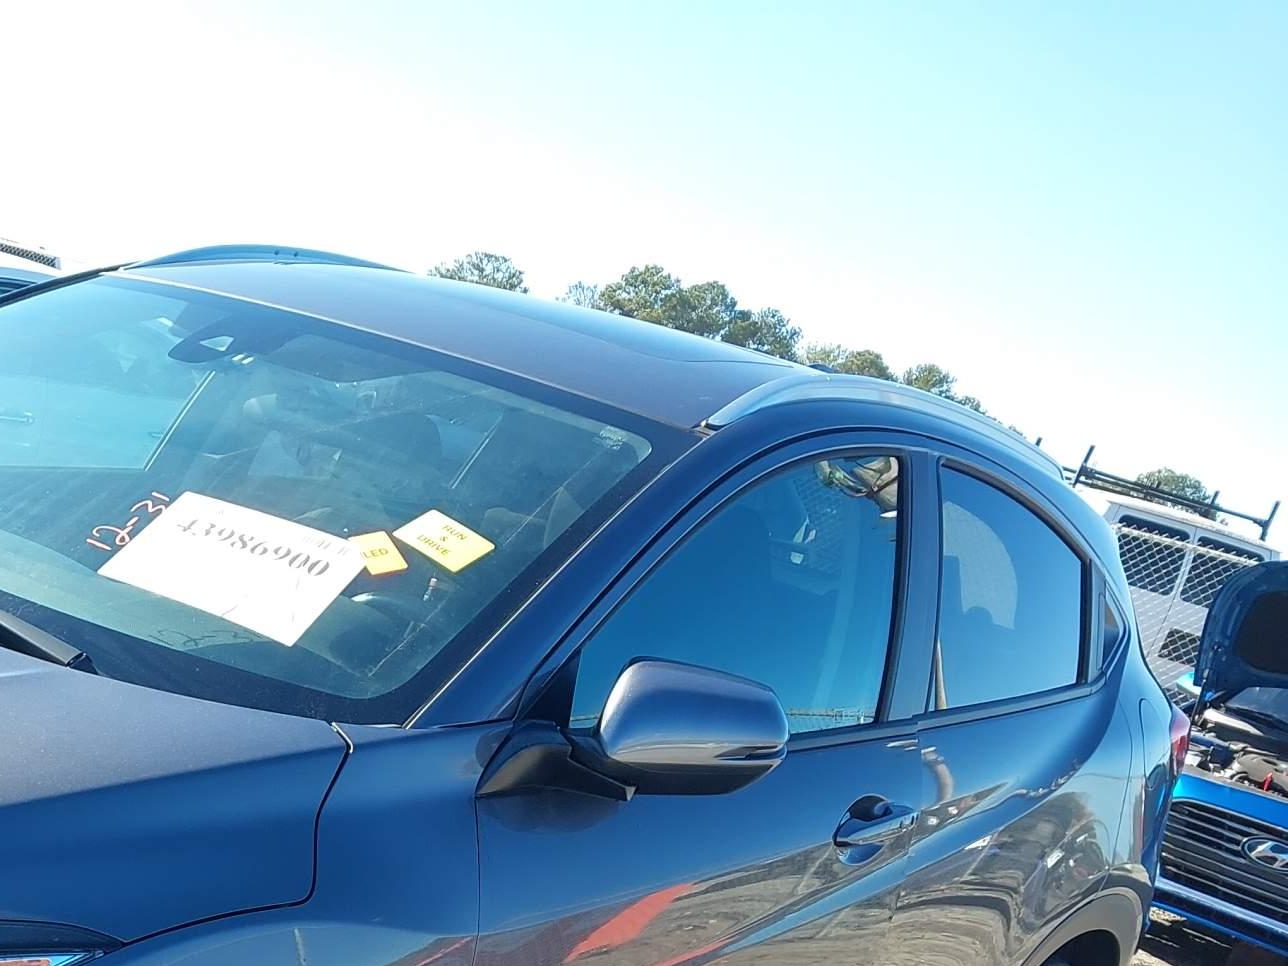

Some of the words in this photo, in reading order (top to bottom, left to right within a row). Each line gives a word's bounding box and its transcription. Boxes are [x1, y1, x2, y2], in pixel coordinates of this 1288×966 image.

[86, 491, 170, 551] 12-31
[441, 524, 468, 541] RUN
[176, 518, 330, 577] 43986900
[362, 547, 389, 559] LED
[417, 534, 452, 556] DRIVE
